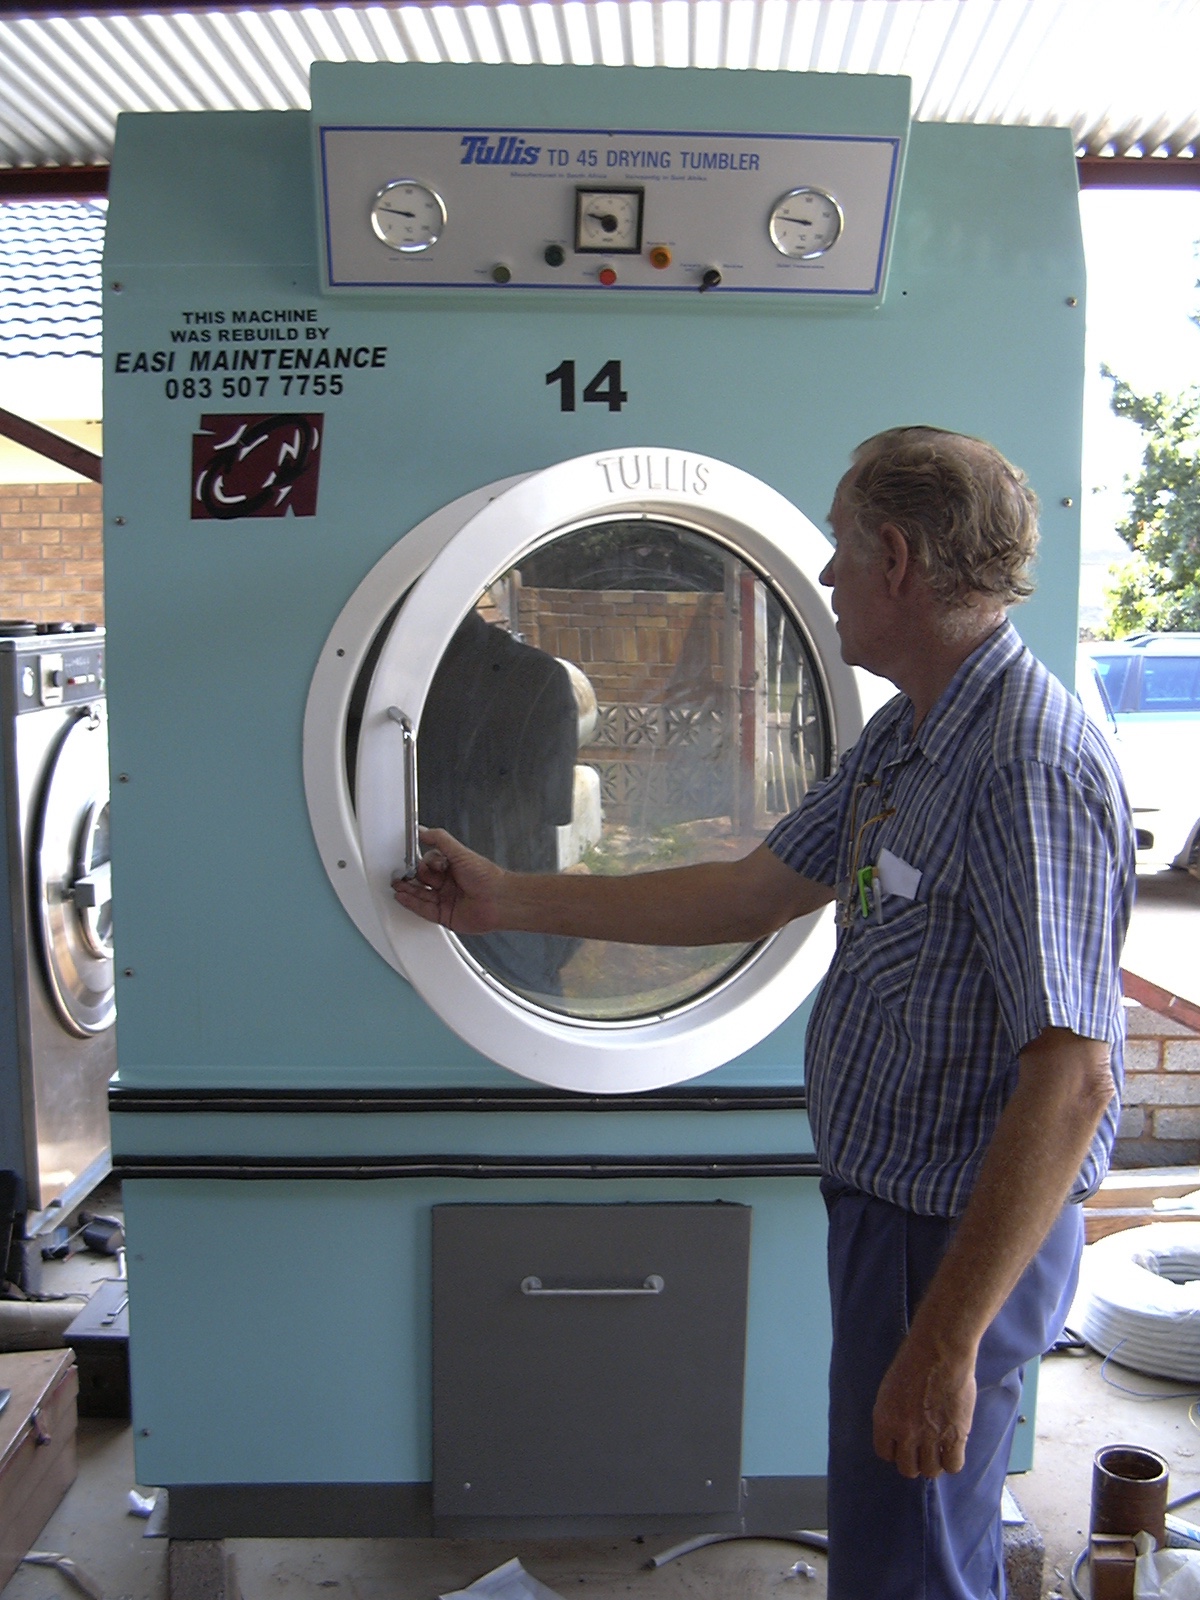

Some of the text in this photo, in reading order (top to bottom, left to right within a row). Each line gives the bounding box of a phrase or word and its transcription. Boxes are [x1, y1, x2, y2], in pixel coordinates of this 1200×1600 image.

[460, 136, 760, 170] Tullis TD 45 DRYING TUMBLER
[182, 309, 318, 325] THIS MACHINE
[170, 327, 330, 343] WAS REBUILD BY
[114, 346, 388, 374] EASI MAINTENANCE
[165, 374, 344, 400] 083 507 7755
[545, 360, 628, 412] 14
[596, 455, 710, 495] TULLIS
